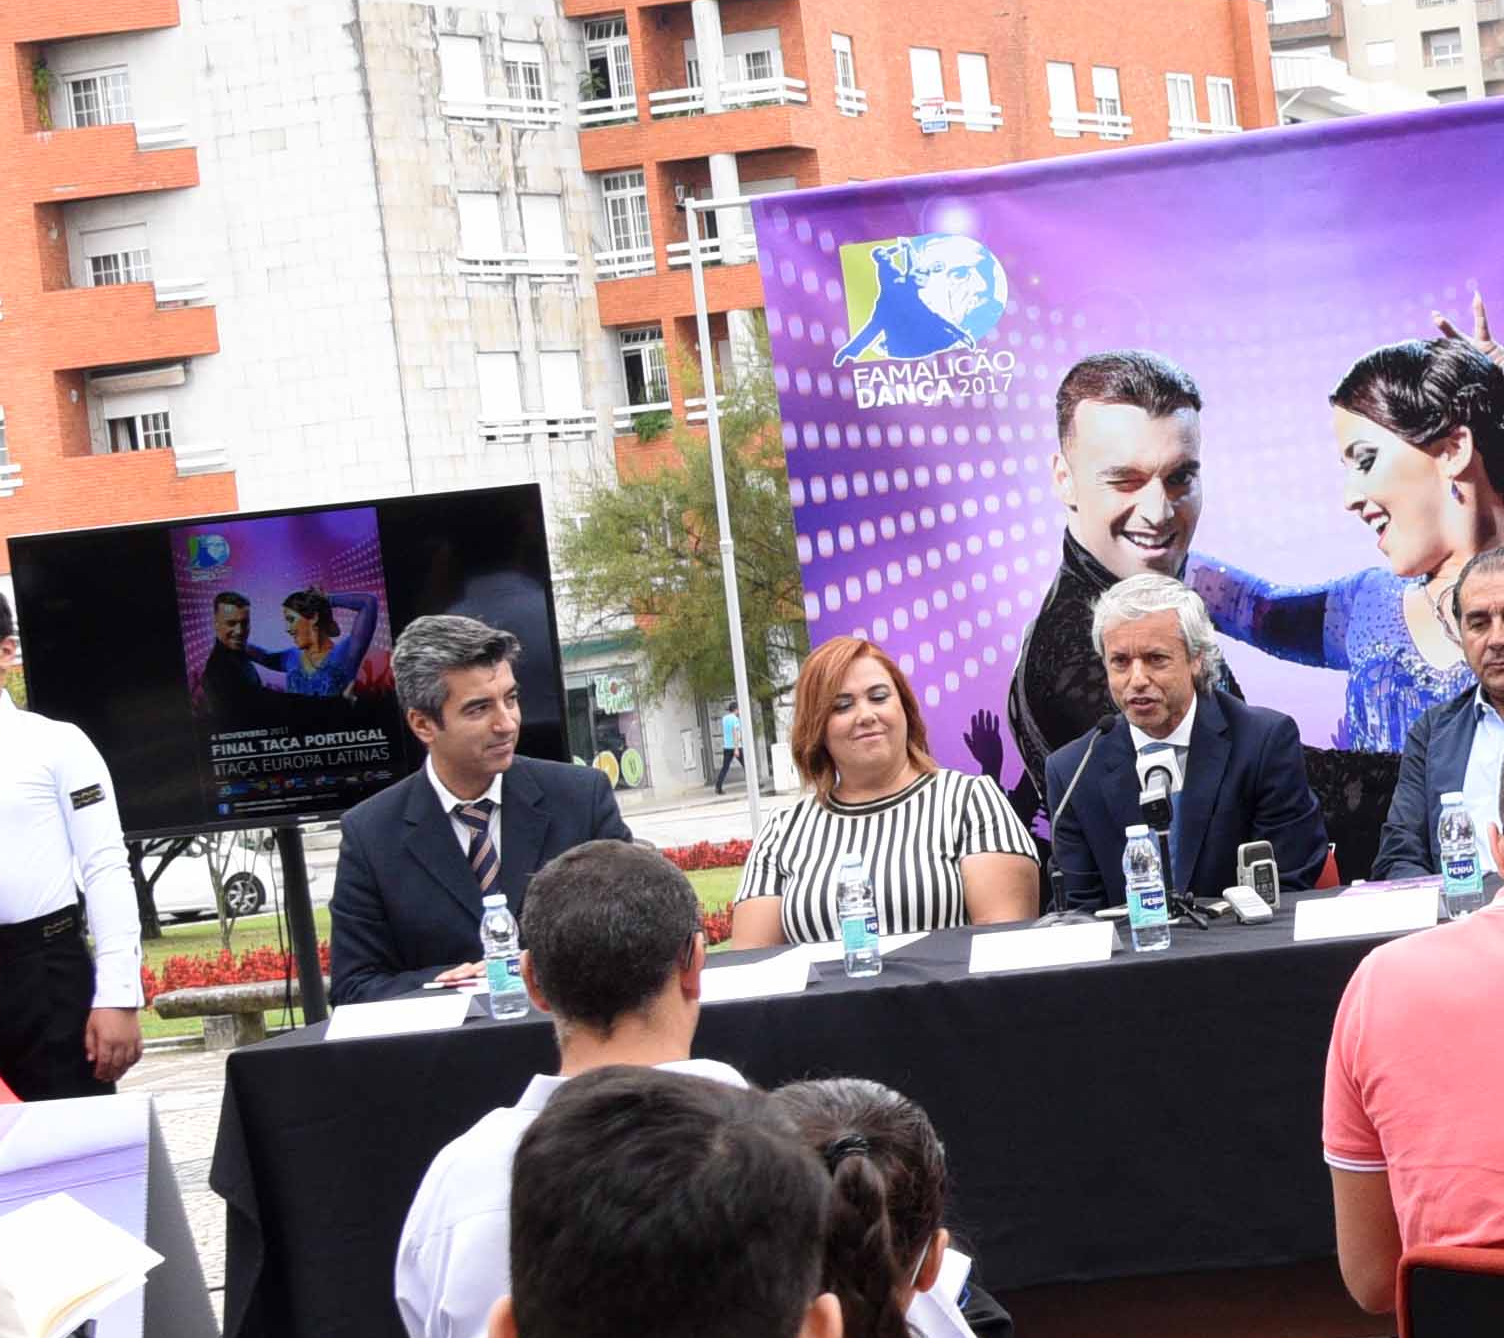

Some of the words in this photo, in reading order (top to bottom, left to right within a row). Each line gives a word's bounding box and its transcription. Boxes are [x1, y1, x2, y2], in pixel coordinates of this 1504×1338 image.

[853, 348, 1016, 389] FAMALICÃO
[856, 378, 955, 409] DANÇA
[958, 373, 1013, 397] 2017
[211, 741, 256, 757] FINAL
[260, 736, 301, 754] TAÇA
[304, 727, 388, 747] PORTUGAL
[263, 754, 325, 772] EUROPA
[327, 746, 390, 766] LATINAS
